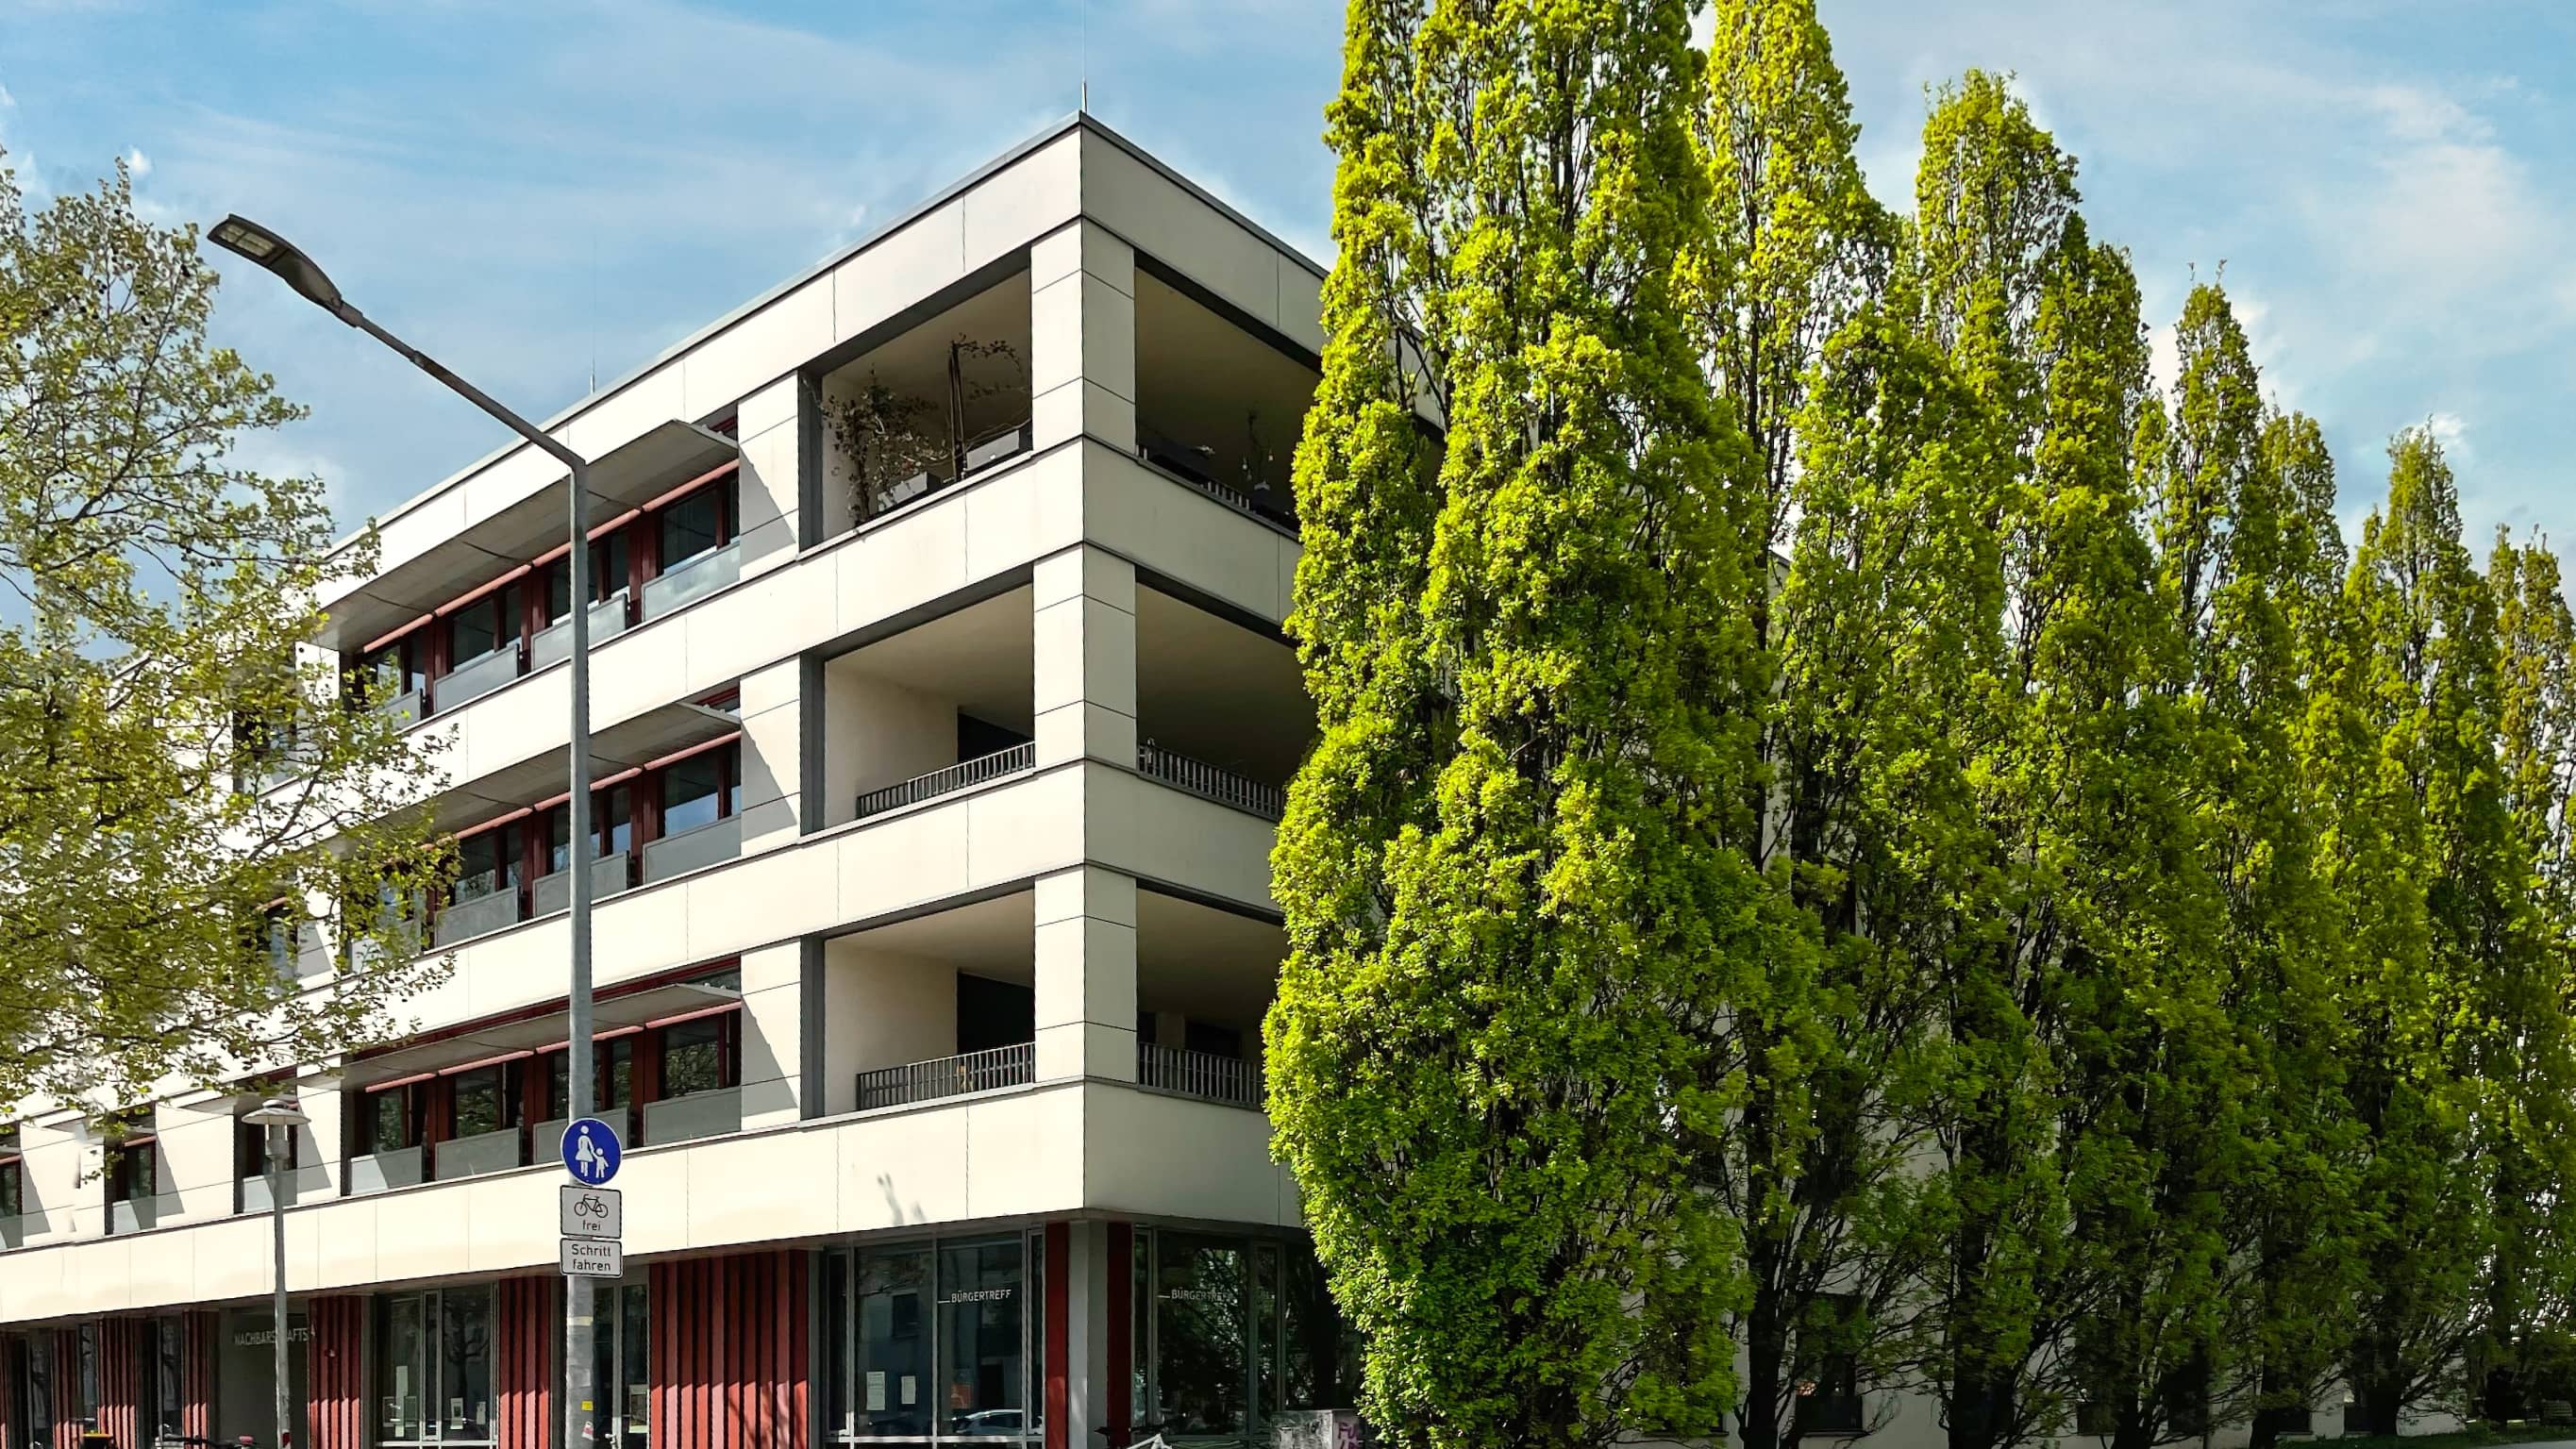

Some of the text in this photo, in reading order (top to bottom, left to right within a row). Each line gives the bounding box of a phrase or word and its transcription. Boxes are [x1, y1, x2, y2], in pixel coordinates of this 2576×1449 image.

[582, 1220, 601, 1231] frei
[572, 1243, 611, 1257] Schritt
[573, 1258, 611, 1271] fahren
